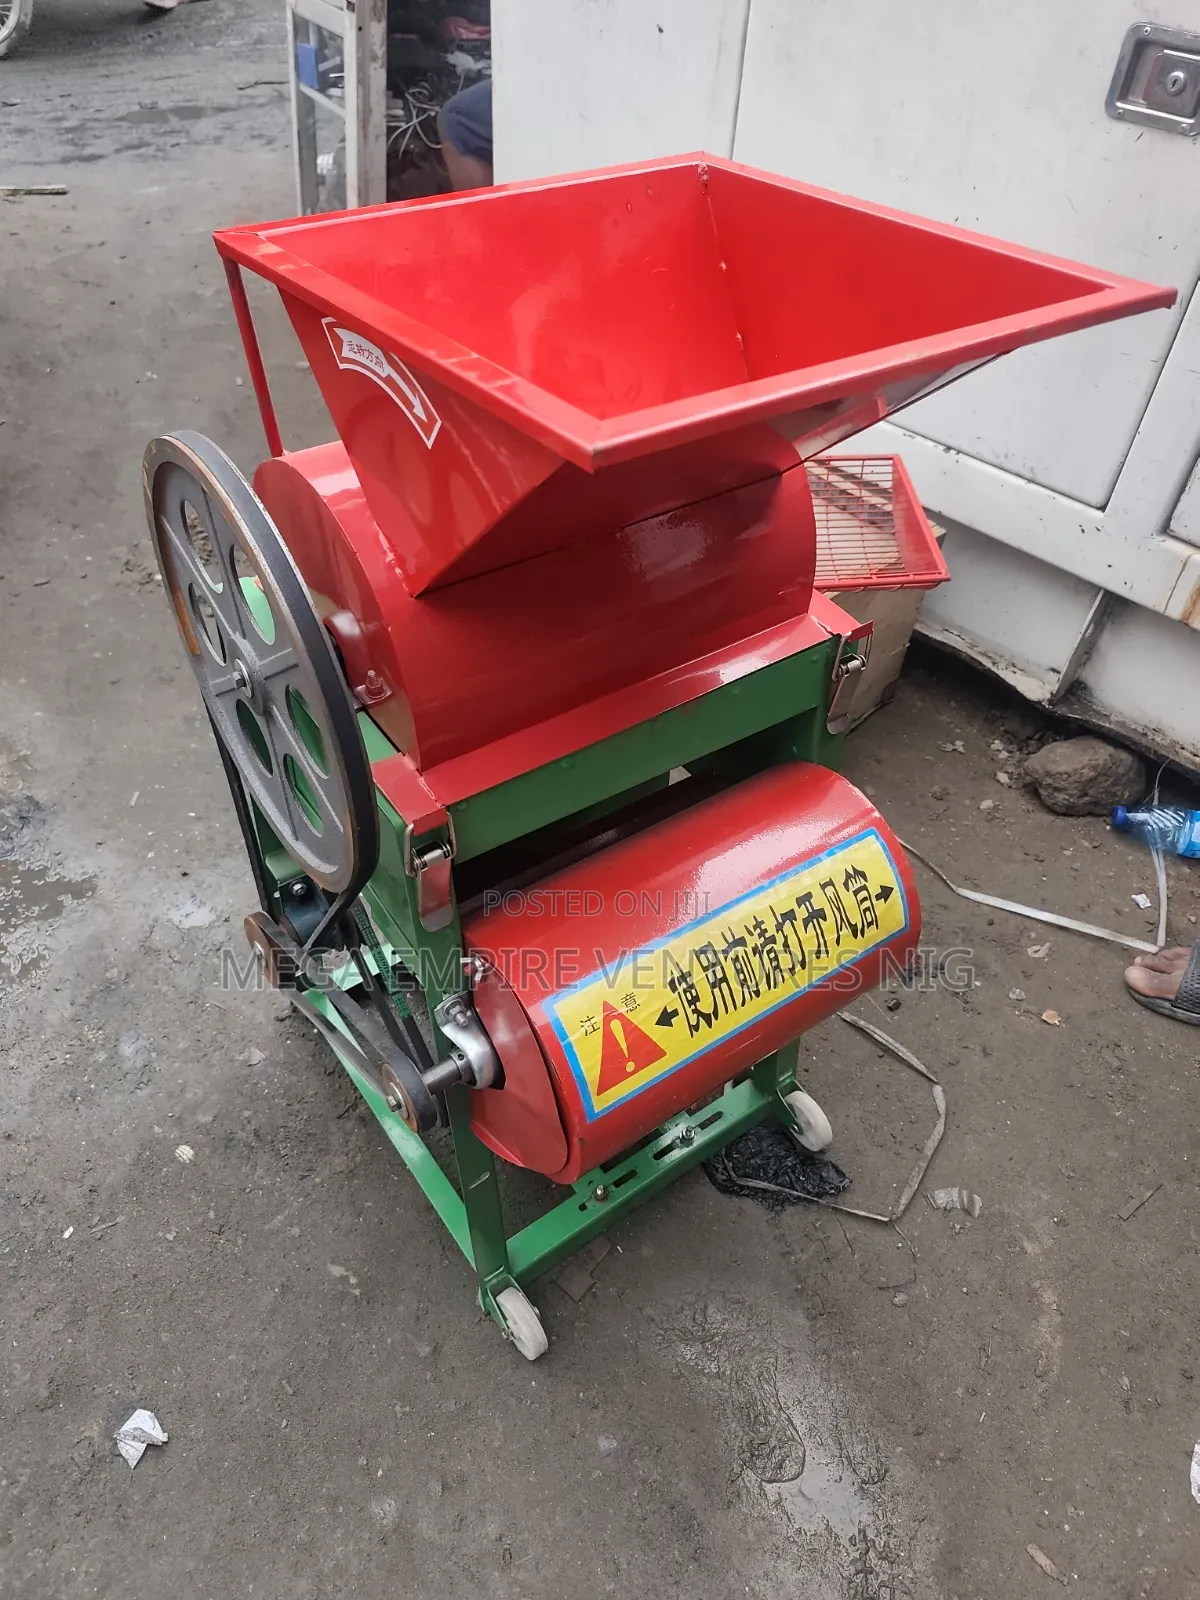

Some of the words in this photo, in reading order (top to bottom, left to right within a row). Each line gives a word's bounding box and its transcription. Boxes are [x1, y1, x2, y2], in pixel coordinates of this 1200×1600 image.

[668, 864, 880, 1038] 使用前请打开风筒
